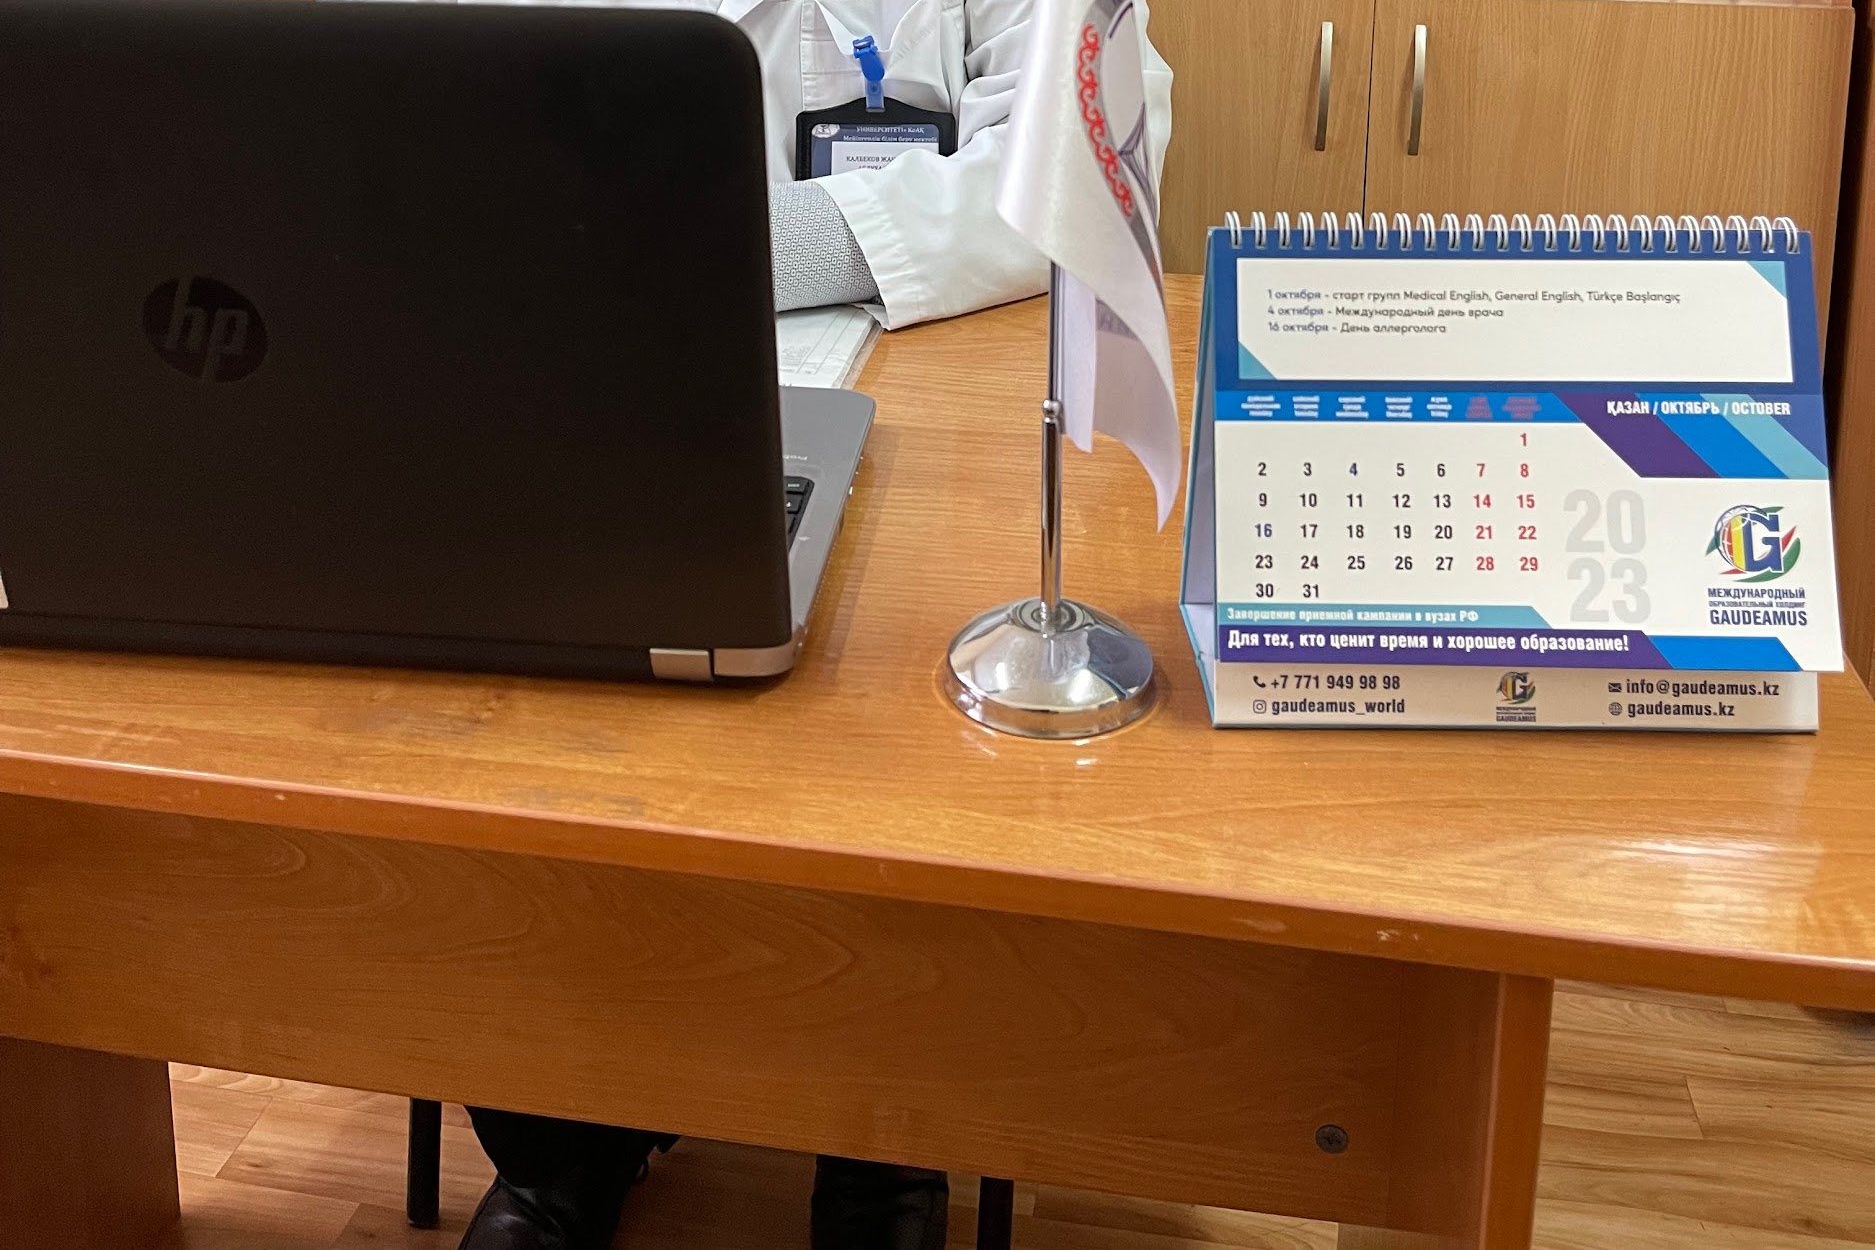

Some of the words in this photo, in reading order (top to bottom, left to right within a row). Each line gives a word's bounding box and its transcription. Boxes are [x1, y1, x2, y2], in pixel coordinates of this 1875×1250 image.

[1267, 289, 1272, 299] 1
[1275, 290, 1321, 302] октября
[1332, 291, 1364, 301] старт
[1368, 292, 1401, 303] групп
[1403, 290, 1447, 300] Medical
[1450, 290, 1492, 303] English,
[1495, 291, 1538, 301] General
[1542, 291, 1583, 303] English,
[1586, 291, 1624, 303] Türkçe
[1267, 307, 1274, 316] 4
[1278, 306, 1324, 318] октября
[1335, 307, 1435, 318] Международный
[1437, 308, 1465, 318] день
[1468, 309, 1504, 318] врача
[165, 276, 249, 383] hp
[1268, 322, 1280, 332] 16
[1283, 322, 1329, 334] октября
[1340, 323, 1370, 334] День
[1373, 324, 1446, 335] аллерголога
[1661, 402, 1720, 415] ОКТЯБРЬ
[1732, 402, 1791, 415] OCTOBER
[1349, 463, 1357, 476] 4
[1437, 463, 1446, 477] 6
[1476, 464, 1485, 477] 7
[1521, 464, 1529, 477] 8
[1562, 489, 1647, 555] 20
[1566, 558, 1651, 624] 23
[1707, 587, 1806, 599] МЕЖДУНАРОДНЫЙ
[1227, 608, 1296, 620] Завершение
[1299, 609, 1354, 622] приемной
[1357, 610, 1412, 622] кампании
[1415, 612, 1422, 621] в
[1424, 612, 1456, 623] вузах
[1459, 611, 1479, 622] РФ
[1710, 610, 1808, 626] GAUDEAMUS
[1228, 630, 1259, 649] Для
[1264, 632, 1294, 649] тех,
[1300, 634, 1325, 647] кто
[1330, 634, 1375, 650] ценит
[1380, 634, 1428, 651] время
[1433, 636, 1442, 648] и
[1447, 635, 1516, 651] хорошее
[1521, 634, 1629, 653] образование!
[1271, 675, 1288, 689] +7
[1294, 676, 1320, 689] 771
[1327, 676, 1354, 689] 949
[1359, 676, 1377, 689] 98
[1383, 676, 1401, 689] 98
[1626, 679, 1780, 696] info@gaudeamus.kz
[1272, 699, 1405, 716] gaudeamus_world
[1628, 702, 1735, 717] gaudeamus.kz
